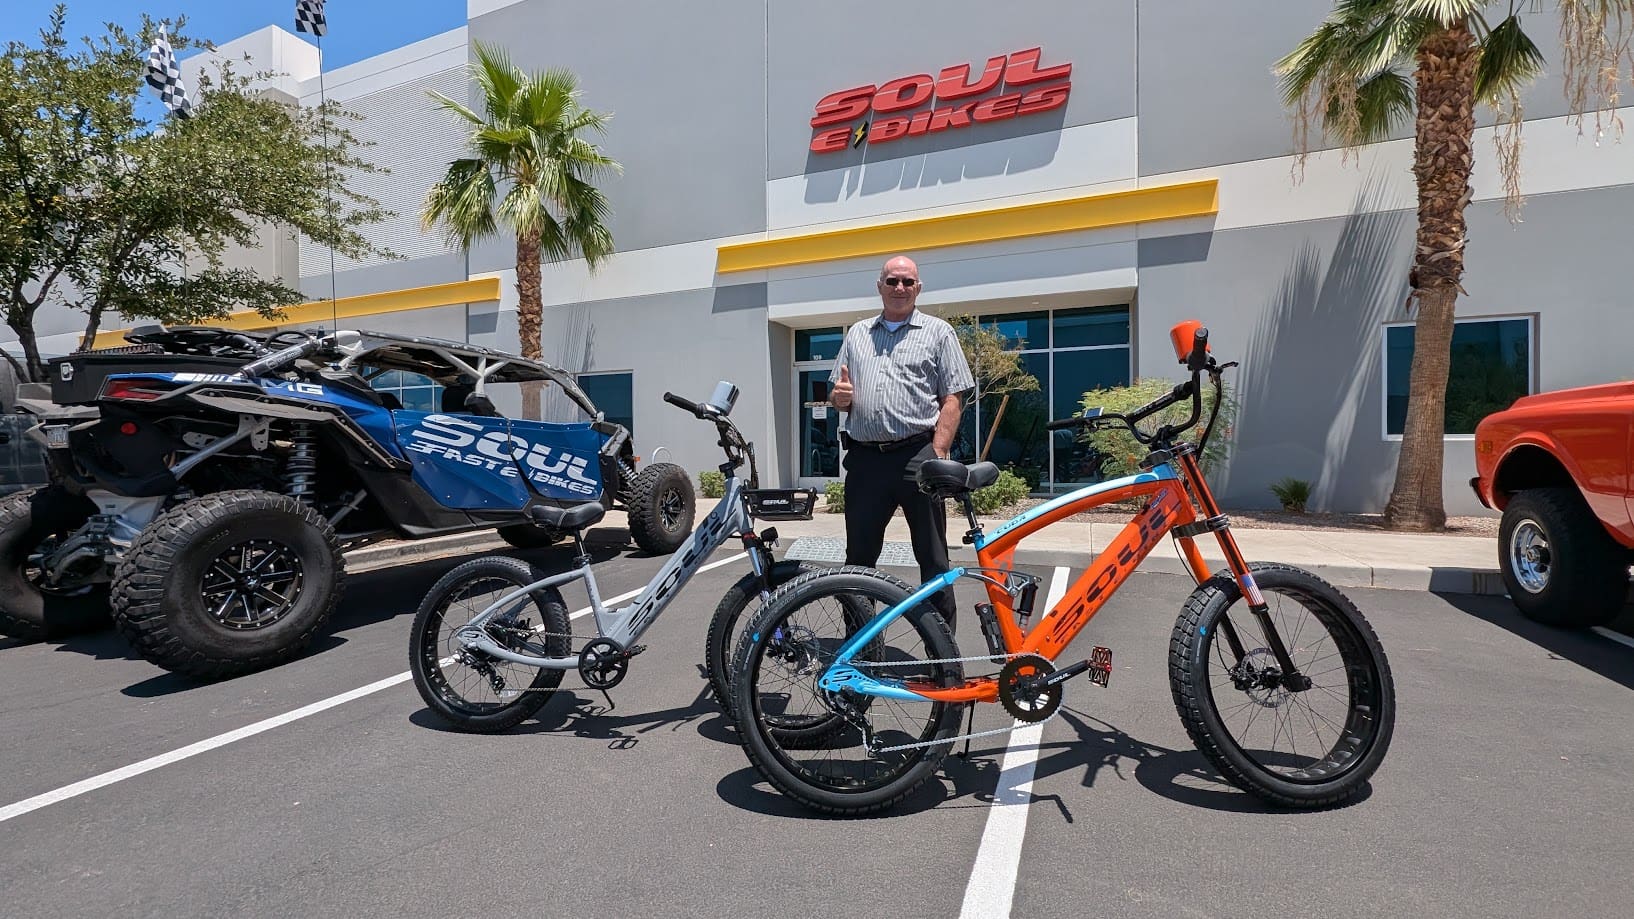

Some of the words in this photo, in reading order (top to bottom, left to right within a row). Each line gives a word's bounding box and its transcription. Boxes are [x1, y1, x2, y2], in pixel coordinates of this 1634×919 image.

[810, 47, 1073, 128] SOUL
[405, 440, 503, 470] FAST
[411, 414, 598, 486] SOUL
[628, 508, 737, 636] SOUL
[1053, 500, 1181, 644] SOUL
